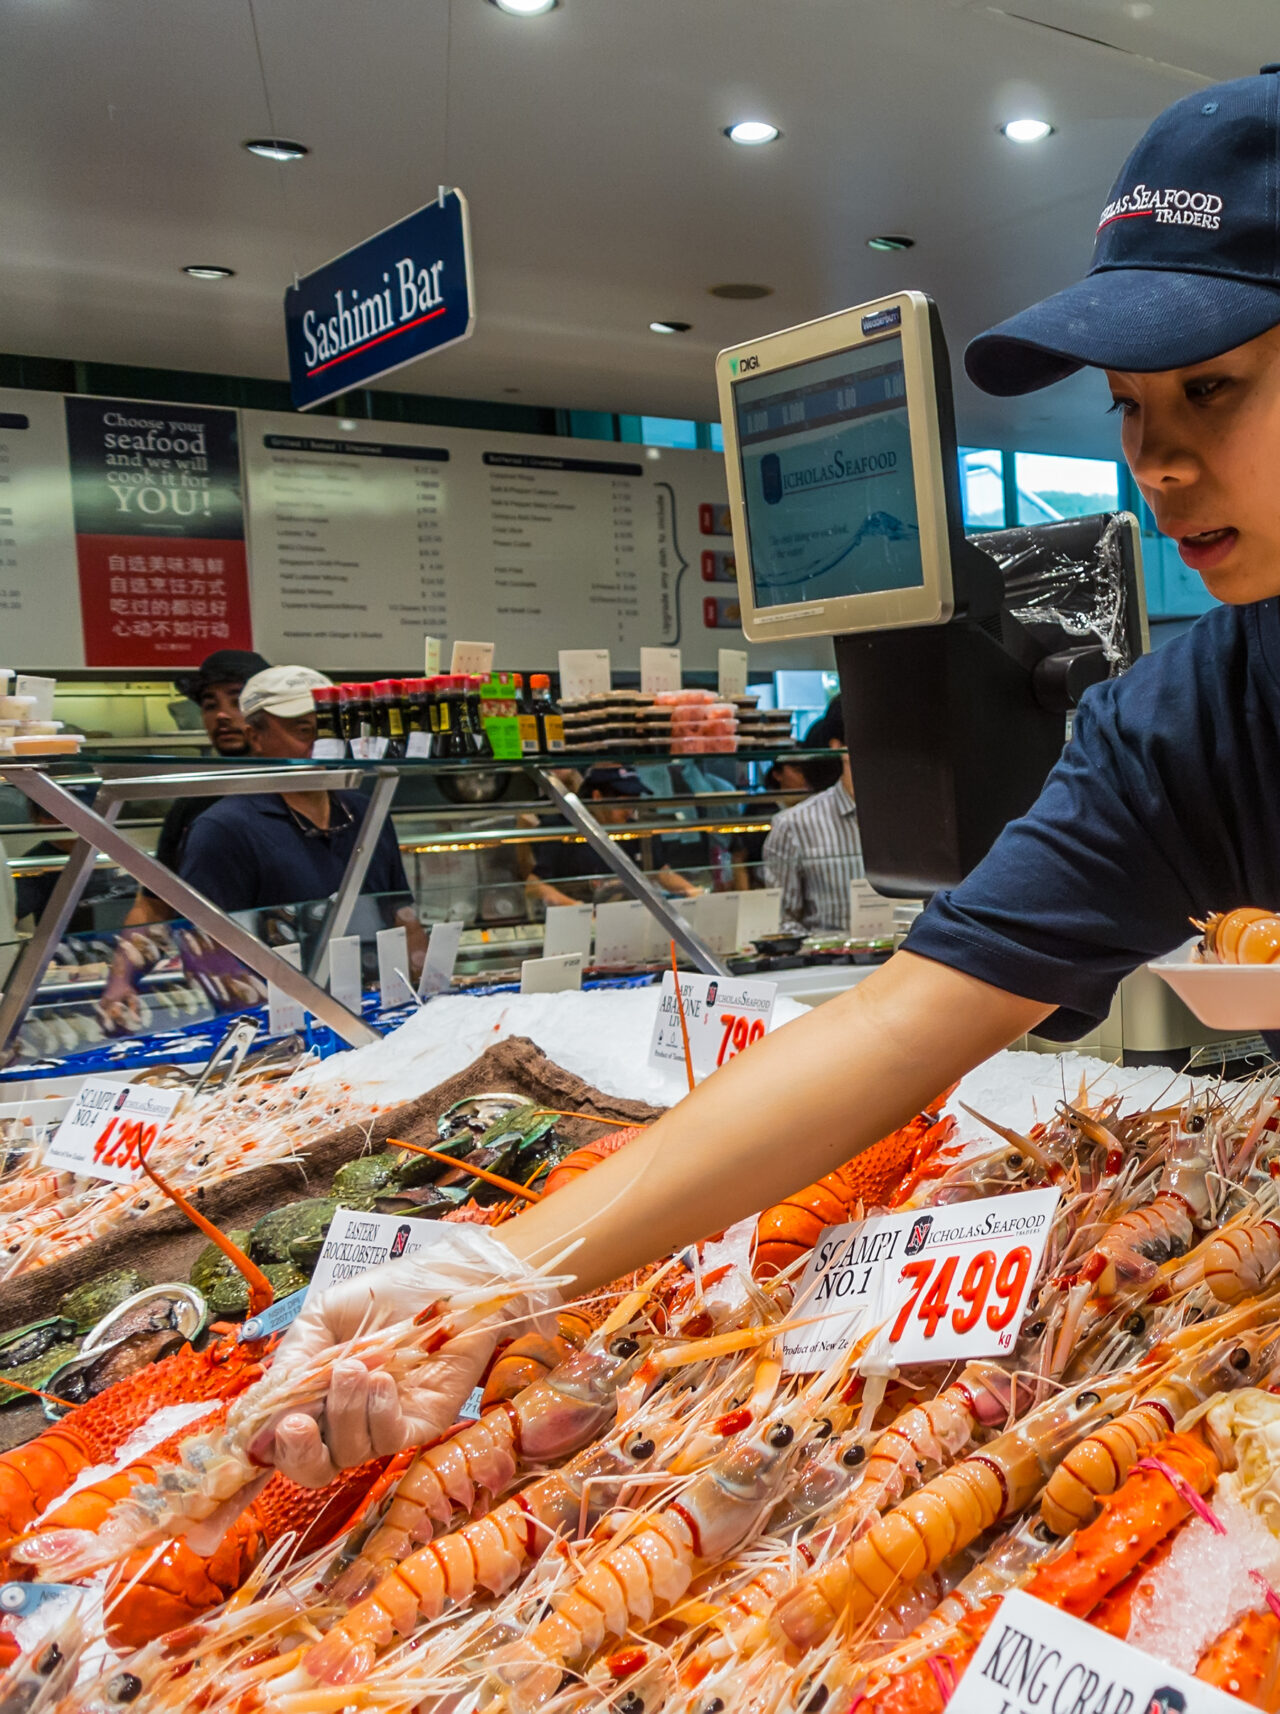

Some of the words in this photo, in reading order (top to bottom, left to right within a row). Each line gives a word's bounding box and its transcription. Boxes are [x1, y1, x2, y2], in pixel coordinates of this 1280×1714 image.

[1156, 209, 1221, 229] TRADERS
[303, 272, 395, 368] Sashimi
[395, 257, 444, 322] Bar
[103, 412, 165, 430] Choose
[166, 420, 207, 434] your
[104, 429, 207, 454] seafood
[106, 452, 143, 467] and
[146, 457, 171, 469] we
[175, 456, 208, 471] will
[106, 467, 156, 486] cook
[161, 470, 177, 486] it
[181, 470, 211, 488] for
[109, 484, 212, 517] YOU!
[108, 555, 224, 575] 自选美味海鲜
[110, 598, 227, 617] 吃过的都说好
[112, 620, 230, 638] 心动不如行动
[660, 995, 701, 1018] ABAONE
[345, 1221, 380, 1242] EASTERN
[323, 1242, 388, 1264] ROCKLOBSTER
[815, 1230, 903, 1272] SCAMPI
[815, 1268, 873, 1300] NO.1
[783, 1344, 808, 1356] Product
[809, 1341, 820, 1353] of
[819, 1341, 838, 1352] New
[998, 1331, 1012, 1349] kg
[981, 1625, 1062, 1705] KING
